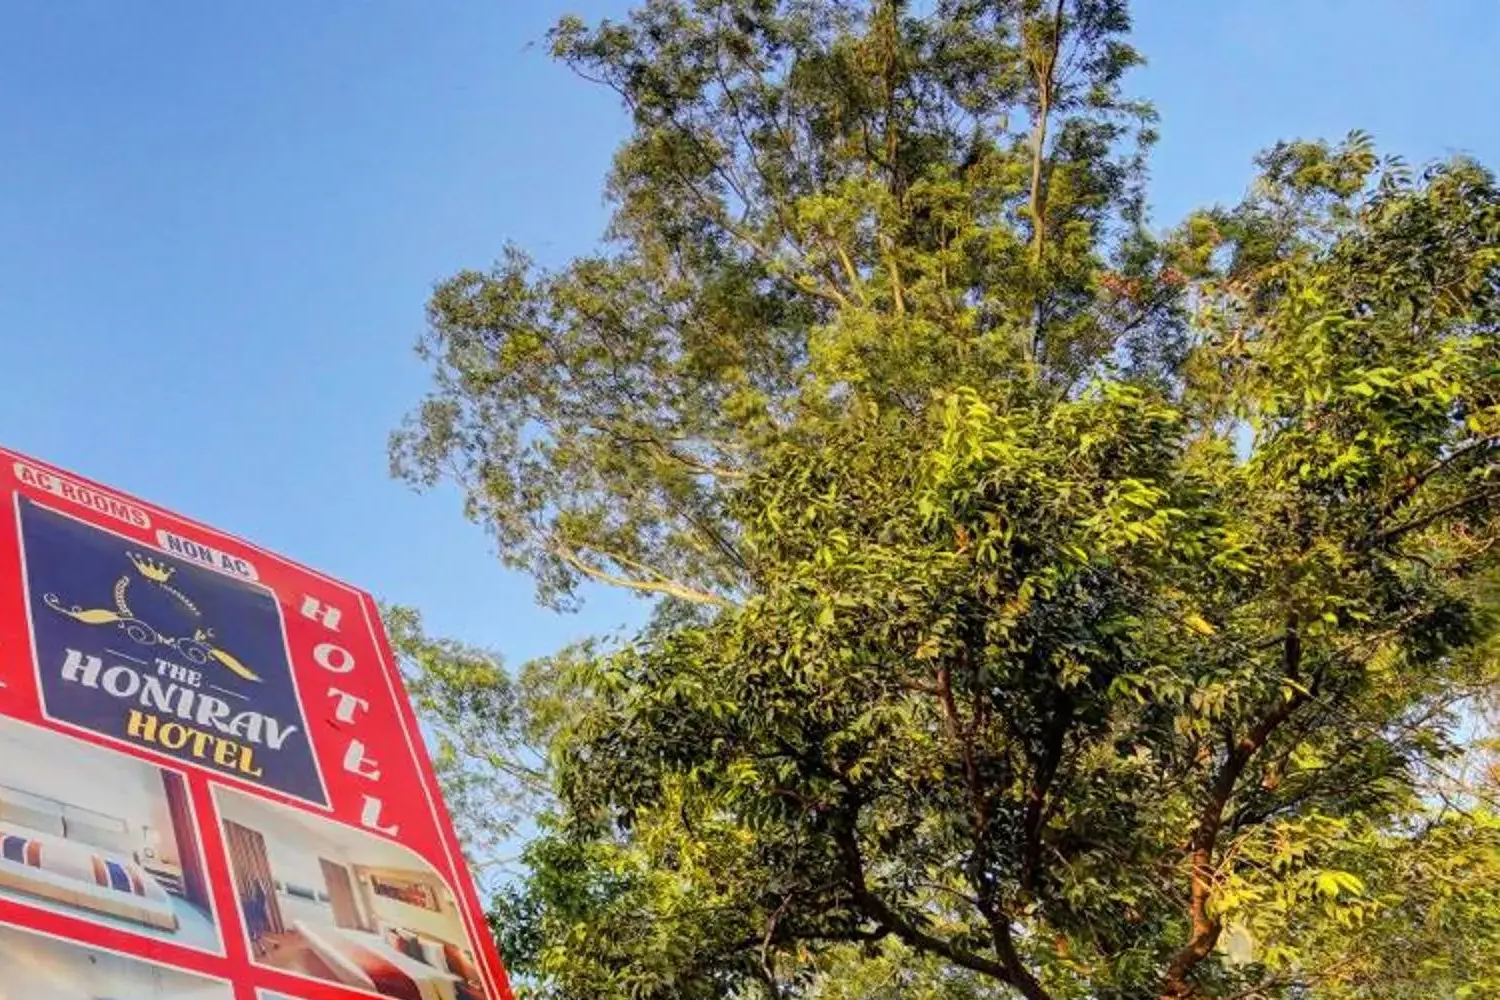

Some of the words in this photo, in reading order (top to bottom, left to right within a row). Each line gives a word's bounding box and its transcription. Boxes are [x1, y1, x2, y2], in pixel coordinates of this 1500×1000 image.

[21, 467, 51, 489] AC
[61, 483, 146, 527] ROOMS
[167, 535, 214, 564] NON
[221, 552, 251, 577] AC
[61, 647, 299, 751] HONIRAV
[155, 657, 202, 687] THE
[127, 709, 263, 778] HOTEL
